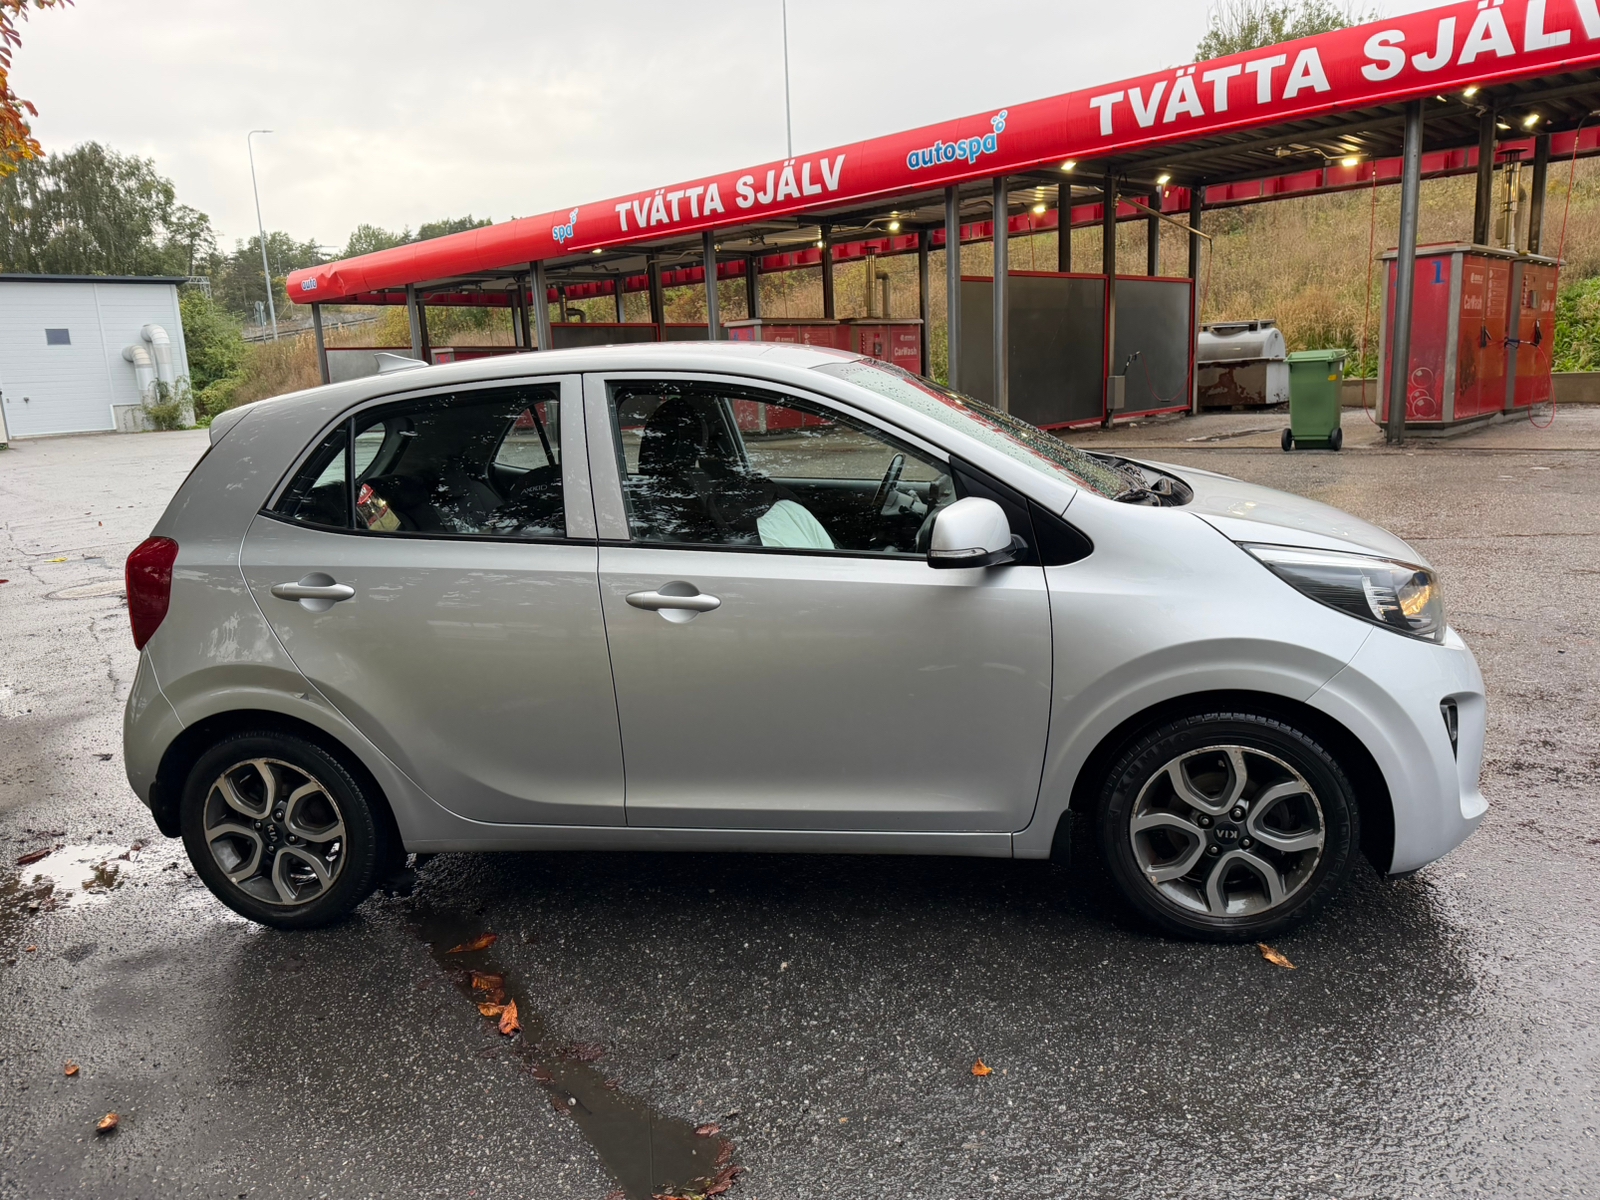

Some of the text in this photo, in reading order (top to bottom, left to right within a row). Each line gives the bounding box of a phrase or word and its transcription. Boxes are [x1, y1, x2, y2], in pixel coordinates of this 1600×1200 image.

[1090, 47, 1330, 136] TVÄTTA
[907, 133, 997, 170] autospa
[615, 155, 846, 231] TVÄTTA SJÄLV
[552, 223, 574, 244] spa
[301, 276, 318, 290] auto
[1431, 260, 1446, 284] 1
[894, 346, 917, 356] CarWash
[1116, 732, 1191, 794] KUMHO
[267, 824, 278, 842] KIA
[1216, 829, 1238, 839] KIA
